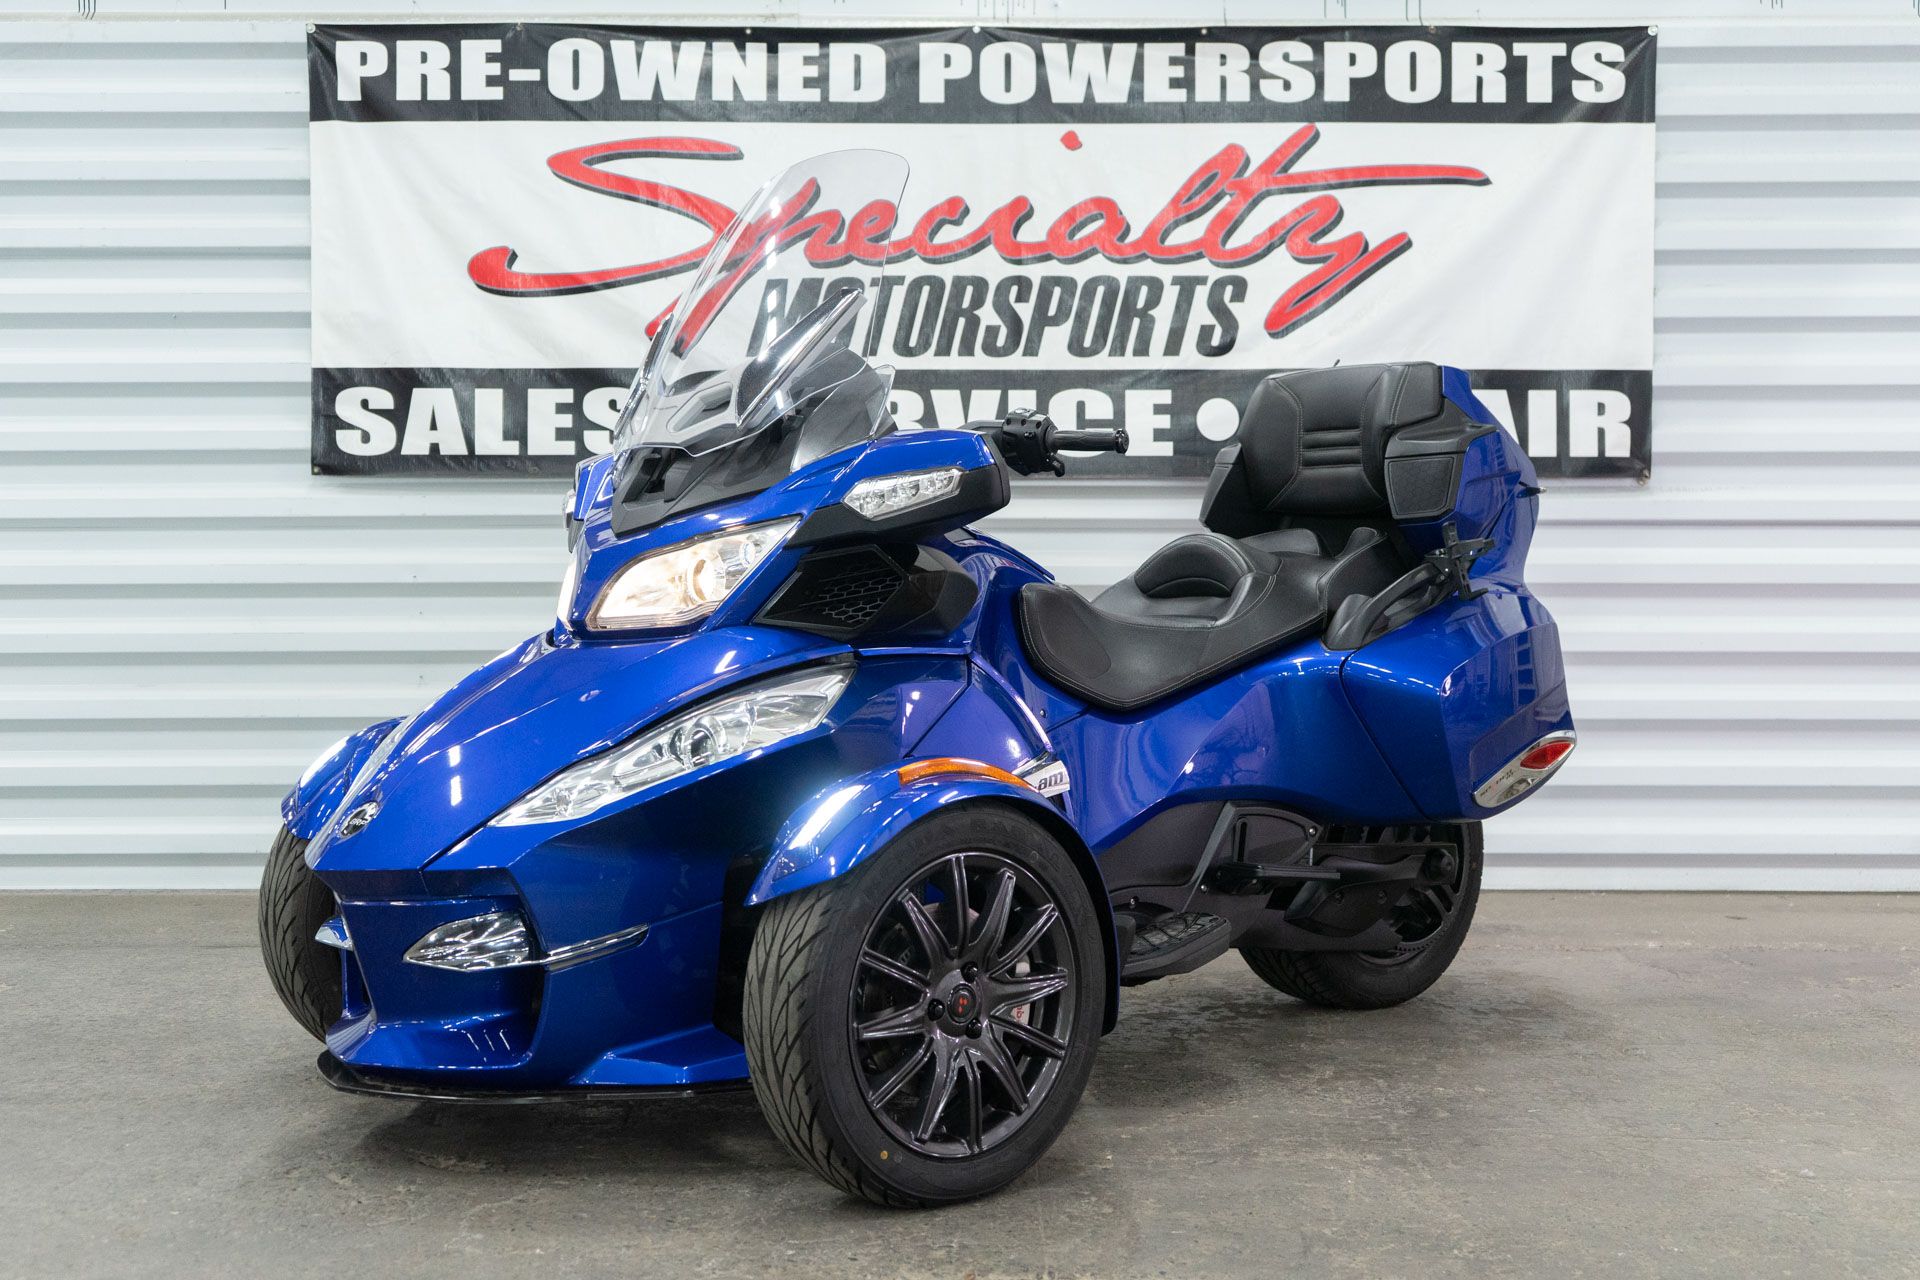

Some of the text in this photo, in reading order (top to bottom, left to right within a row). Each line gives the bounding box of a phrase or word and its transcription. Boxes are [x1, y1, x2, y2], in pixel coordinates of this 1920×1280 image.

[336, 38, 1625, 104] PRE-OWNED POWERSPORTS
[467, 123, 1491, 357] Specialty
[746, 275, 1248, 358] MOTORSPORTS
